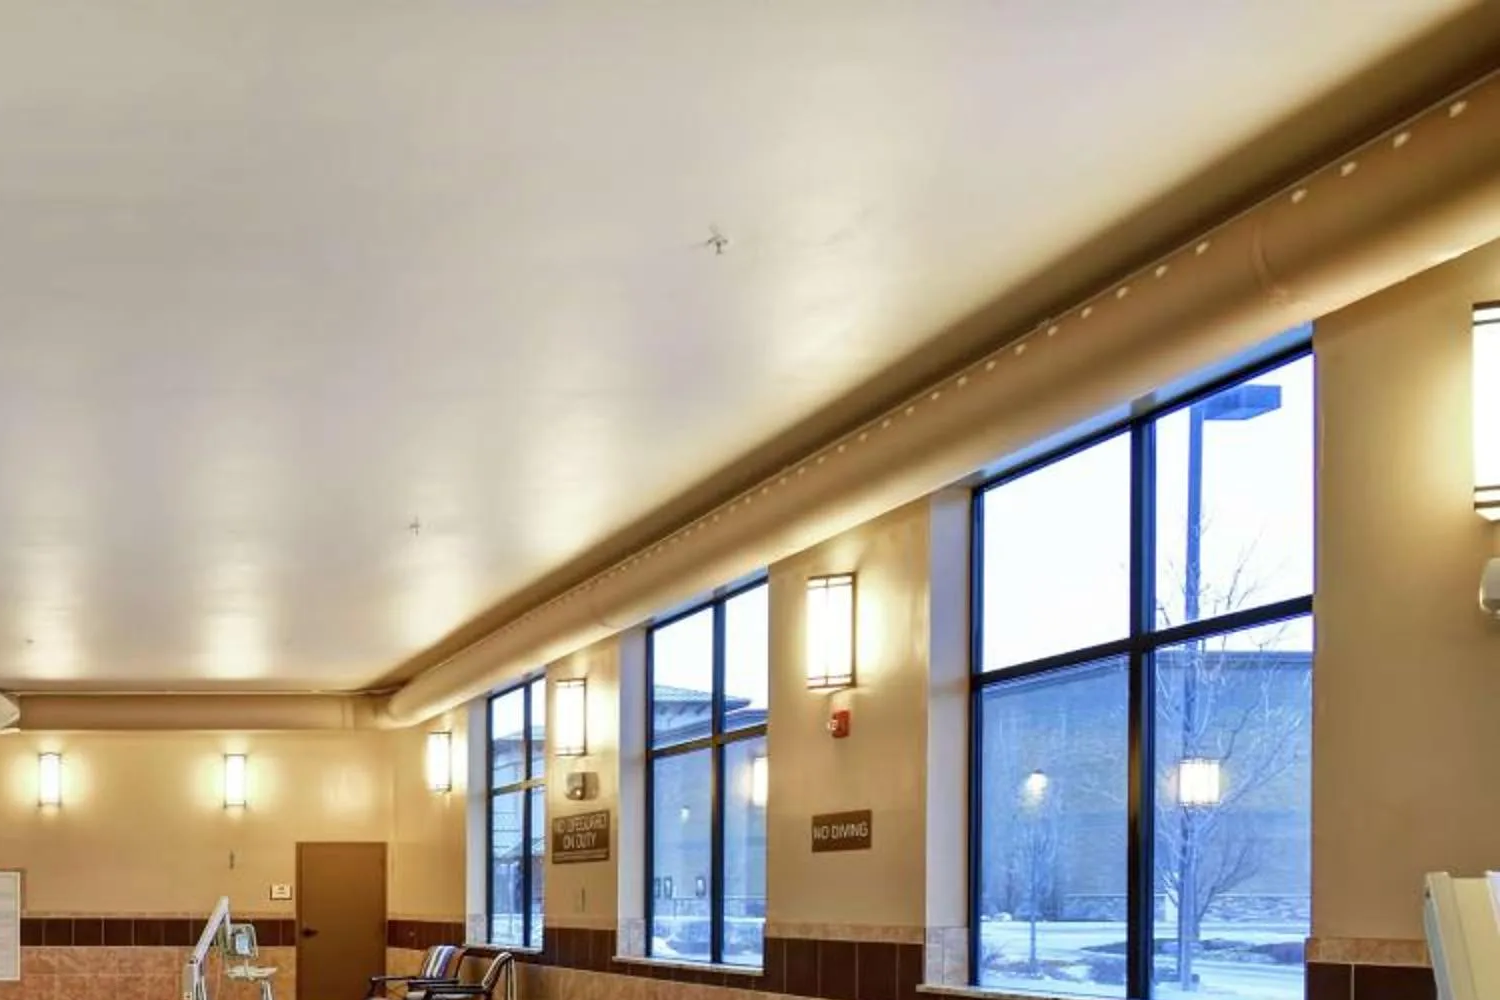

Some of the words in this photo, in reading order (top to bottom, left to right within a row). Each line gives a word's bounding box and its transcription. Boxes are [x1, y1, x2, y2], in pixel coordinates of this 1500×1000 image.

[813, 825, 830, 840] NO
[831, 820, 869, 839] DIVING
[563, 834, 575, 850] ON
[575, 832, 597, 849] DUTY
